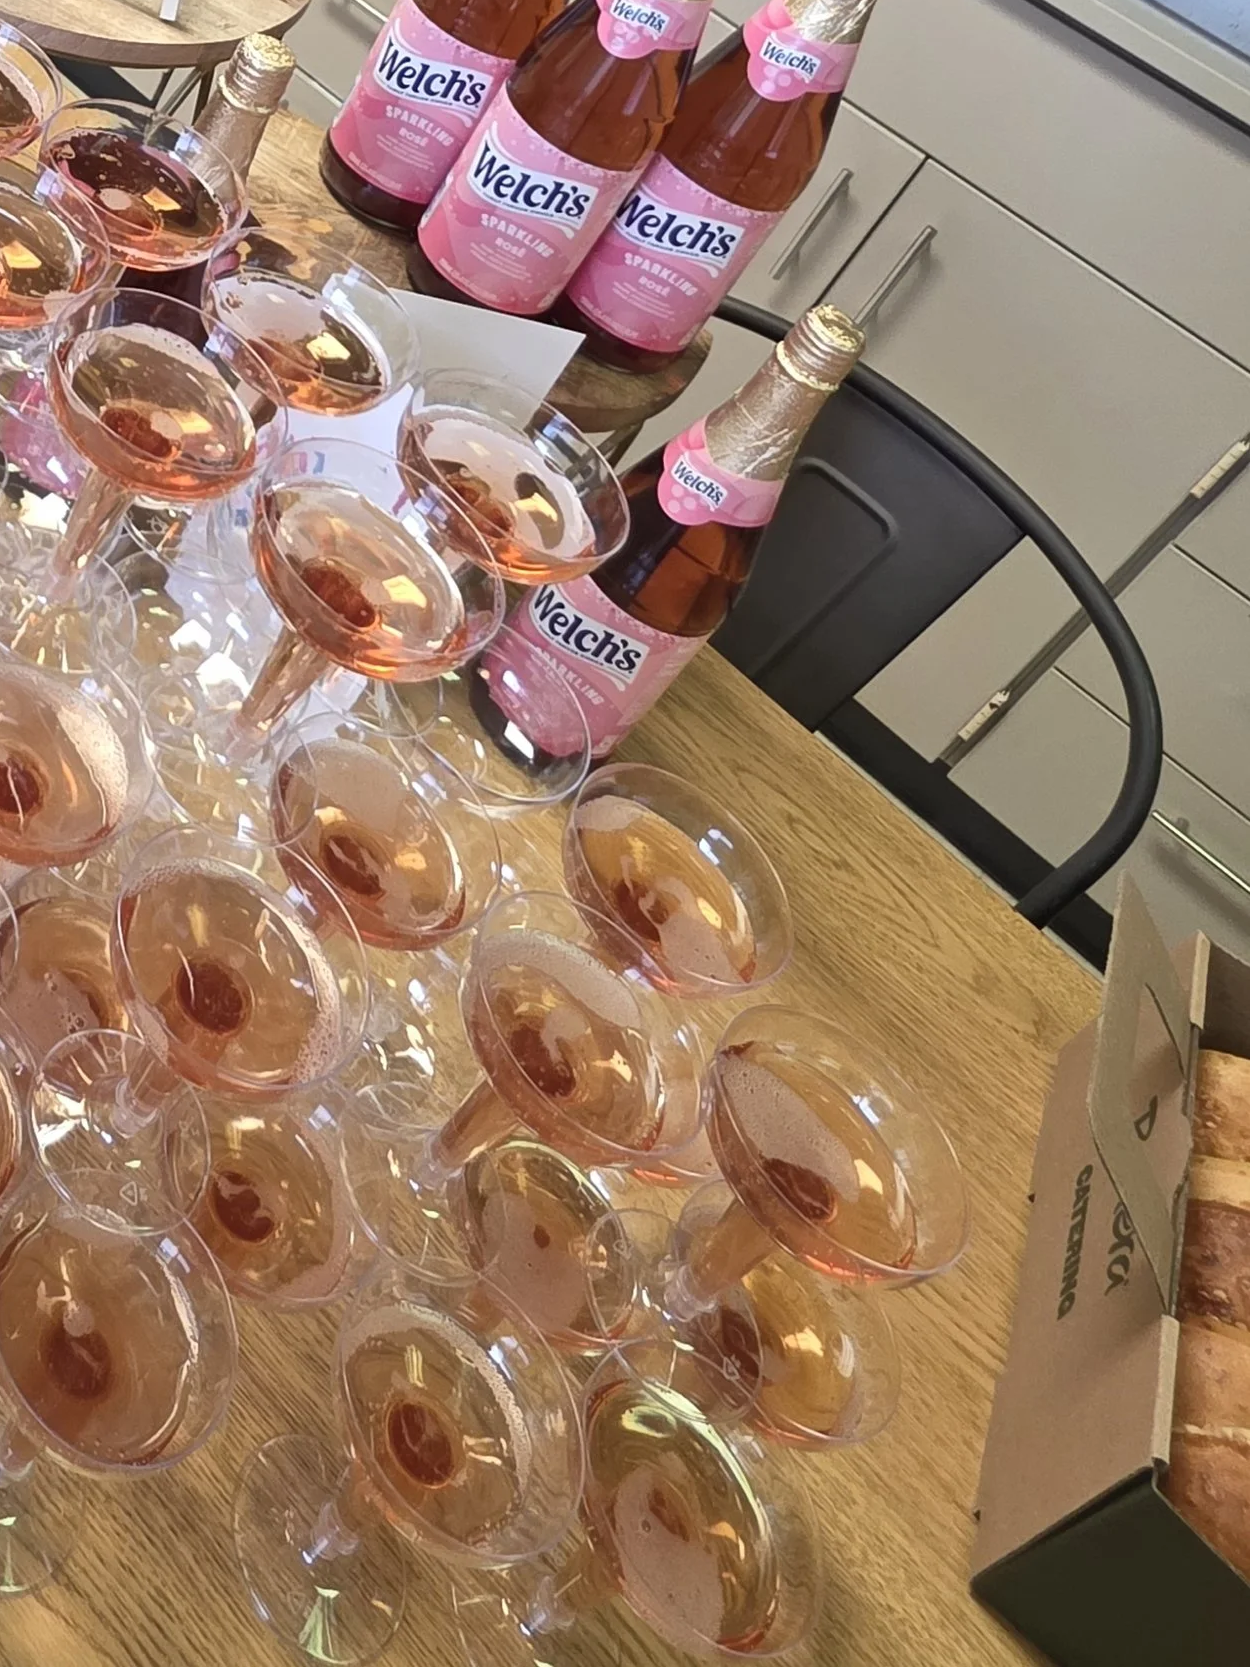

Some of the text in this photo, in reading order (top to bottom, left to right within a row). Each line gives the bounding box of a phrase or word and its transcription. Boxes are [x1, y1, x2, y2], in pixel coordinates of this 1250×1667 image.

[378, 36, 486, 107] Welch's
[763, 41, 817, 75] Welch's
[473, 139, 591, 218] Welch's
[616, 194, 736, 259] Welch's
[674, 460, 724, 504] Welch's
[534, 584, 642, 671] Welch's
[1057, 1164, 1093, 1321] CATERING
